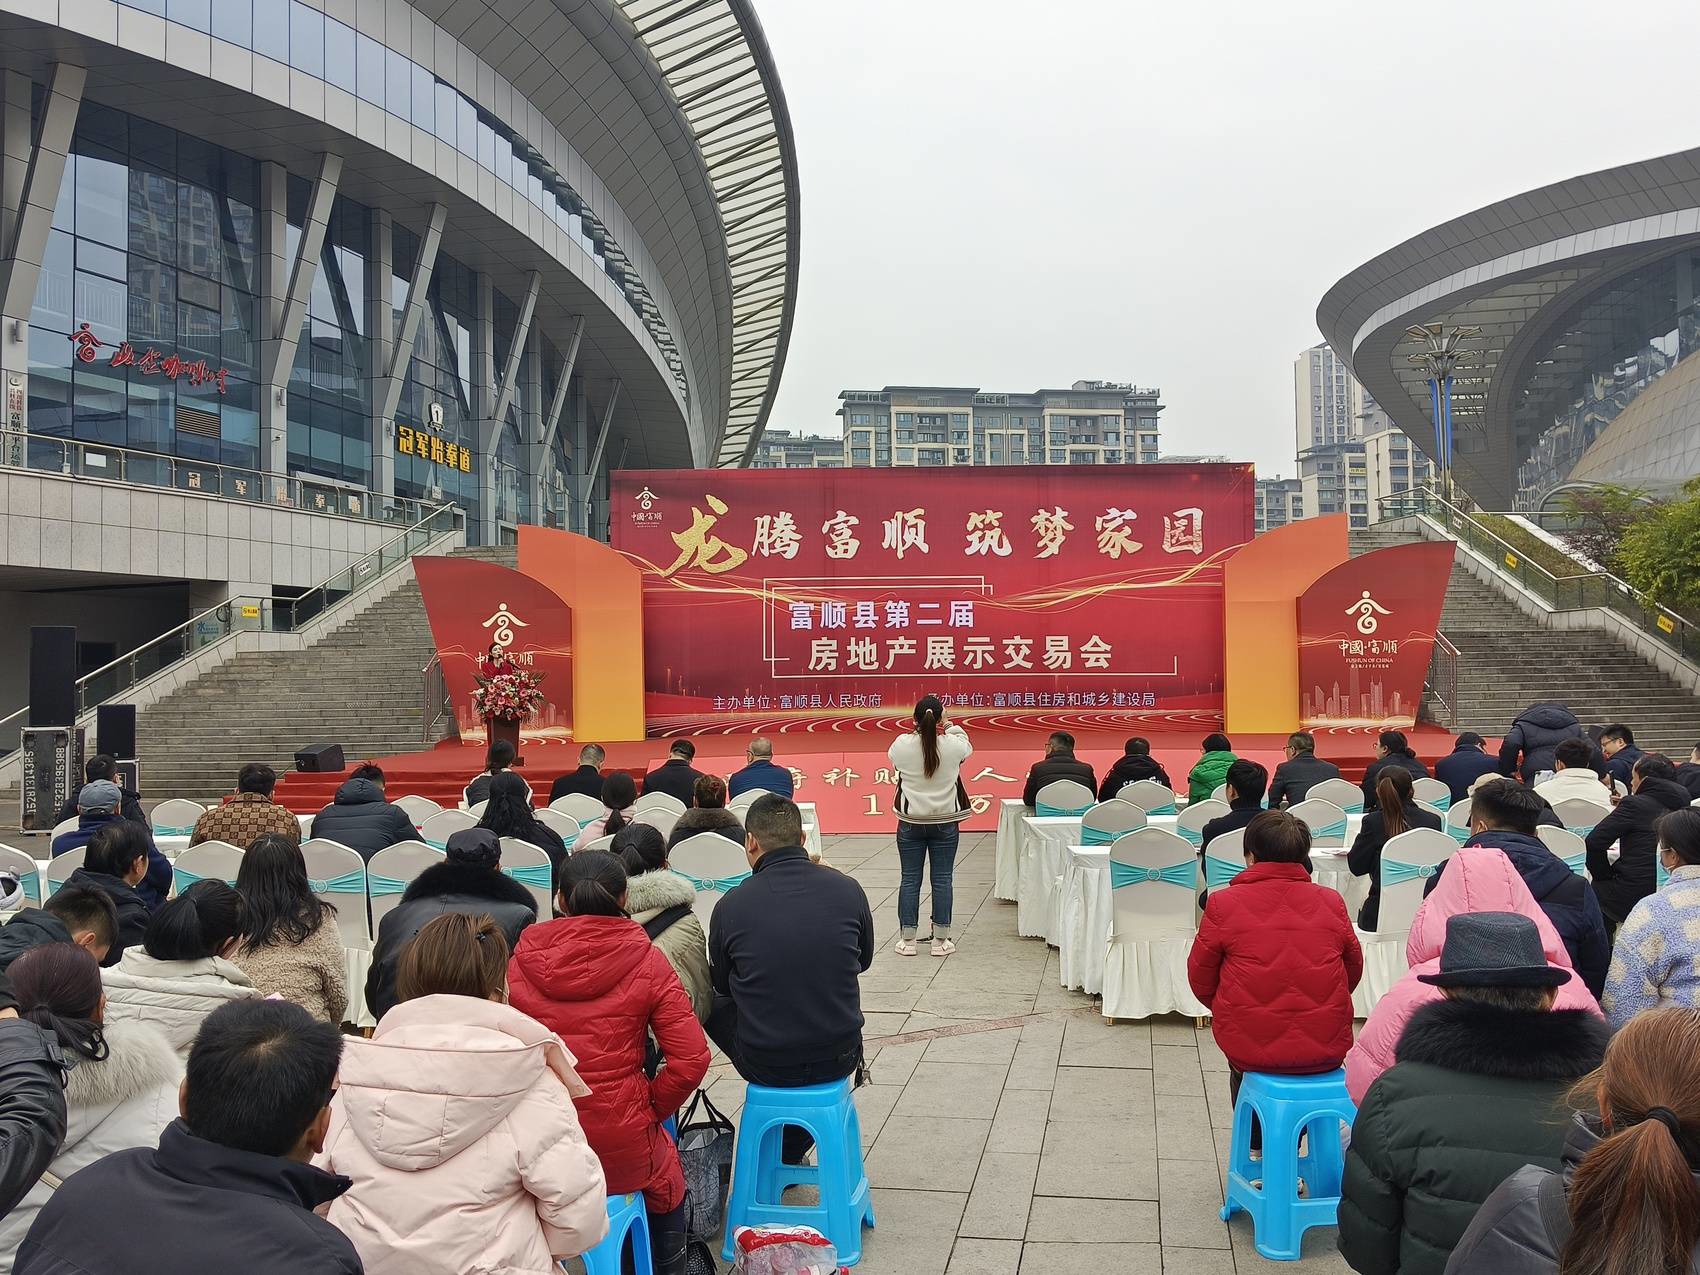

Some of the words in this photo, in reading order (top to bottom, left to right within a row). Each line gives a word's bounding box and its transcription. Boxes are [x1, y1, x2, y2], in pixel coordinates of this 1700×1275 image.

[398, 425, 471, 473] 冠军跆拳道
[964, 506, 1204, 559] 筑梦家园
[788, 600, 975, 630] 富顺县第二届
[807, 635, 1113, 671] 房地产展示交易会
[928, 692, 1156, 708] 办单位：富顺县住房和城乡建设局
